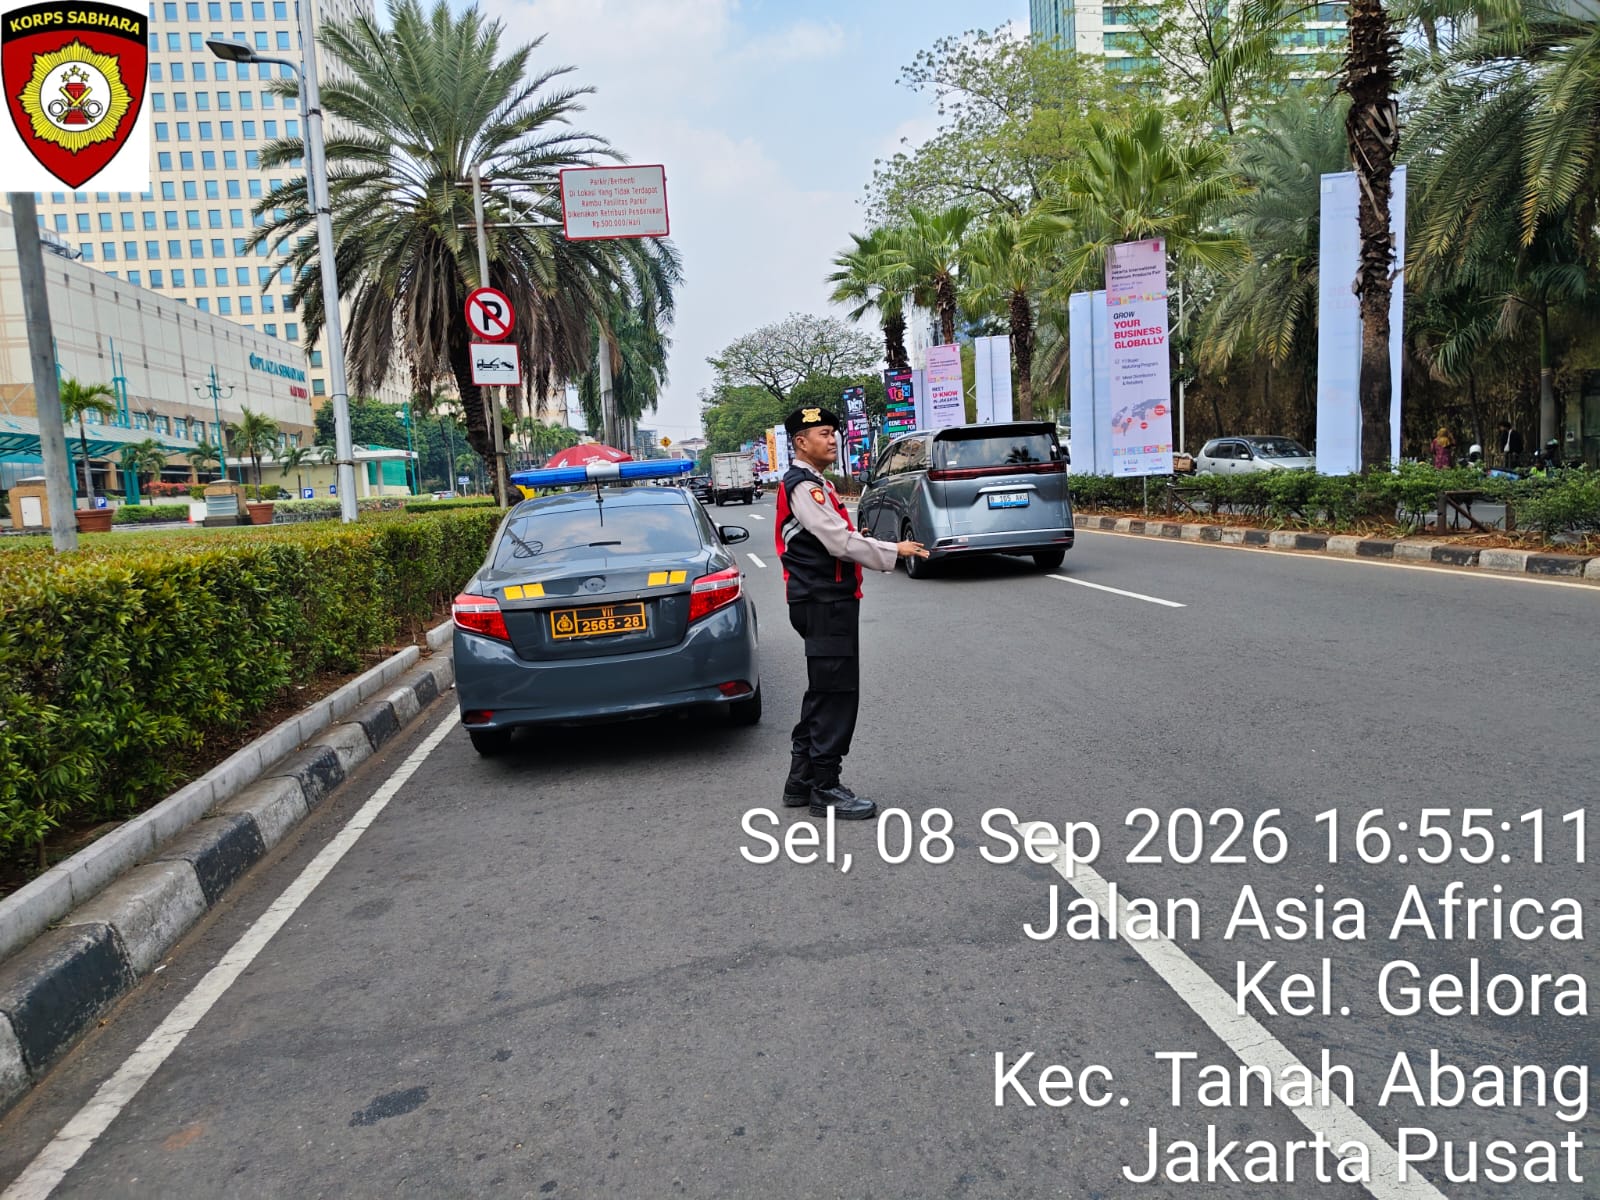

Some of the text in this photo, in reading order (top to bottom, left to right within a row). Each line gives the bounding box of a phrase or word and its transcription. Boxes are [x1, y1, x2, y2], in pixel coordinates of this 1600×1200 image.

[577, 189, 596, 197] Lokasi
[597, 189, 613, 198] Yang
[631, 187, 658, 195] Terdapat
[630, 198, 647, 206] Parkir
[567, 210, 599, 218] Dikenakan
[1113, 311, 1135, 319] GROW
[1114, 319, 1141, 329] YOUR
[1114, 326, 1162, 339] BUSINESS
[1114, 336, 1164, 349] GLOBALLY
[305, 490, 312, 498] P
[98, 498, 105, 507] P
[601, 607, 614, 617] VII
